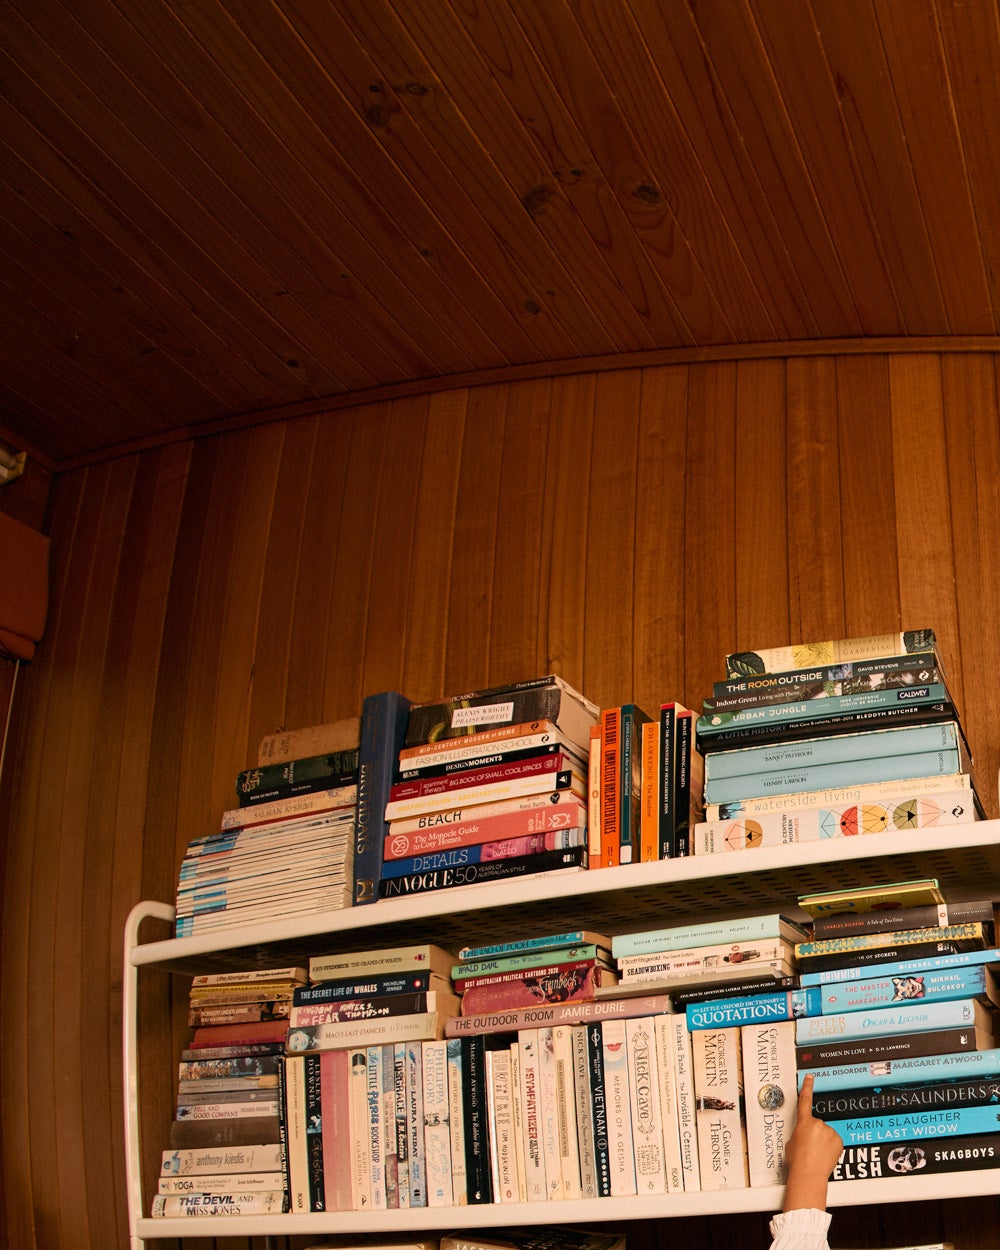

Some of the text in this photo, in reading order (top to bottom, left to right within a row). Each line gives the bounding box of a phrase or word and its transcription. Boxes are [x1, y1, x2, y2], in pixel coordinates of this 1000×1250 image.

[726, 672, 822, 692] THE ROOM OUTSIDE
[732, 705, 807, 722] URBAN JUNGLE
[419, 811, 462, 828] BEACH
[413, 826, 479, 844] The Monocle Guide
[421, 840, 437, 849] Cosy
[438, 836, 461, 846] Homes
[412, 850, 468, 871] DETAILS
[385, 866, 478, 896] IN VOGUE 50
[301, 984, 378, 999] THE SECRET LIFE OF WHALES
[560, 1001, 626, 1019] JAMIE DURIE
[692, 1002, 786, 1027] QUOTATIONS
[455, 1010, 554, 1030] THE OUTDOOR ROOM
[893, 1054, 982, 1070] MARGARET ATWOOD
[811, 1069, 831, 1078] ORAL
[815, 1086, 986, 1113] GEORGE SAUNDERS
[594, 1086, 605, 1139] VIETNAM
[846, 1112, 961, 1130] KARIN SLAUGHTER
[850, 1124, 958, 1141] THE LAST WIDOW
[935, 1147, 994, 1160] SKAGBOYS
[833, 1162, 882, 1180] ELSH
[174, 1182, 194, 1190] YOGA
[180, 1196, 200, 1206] THE
[202, 1194, 235, 1206] DEVIL
[187, 1205, 240, 1216] MISS JONES
